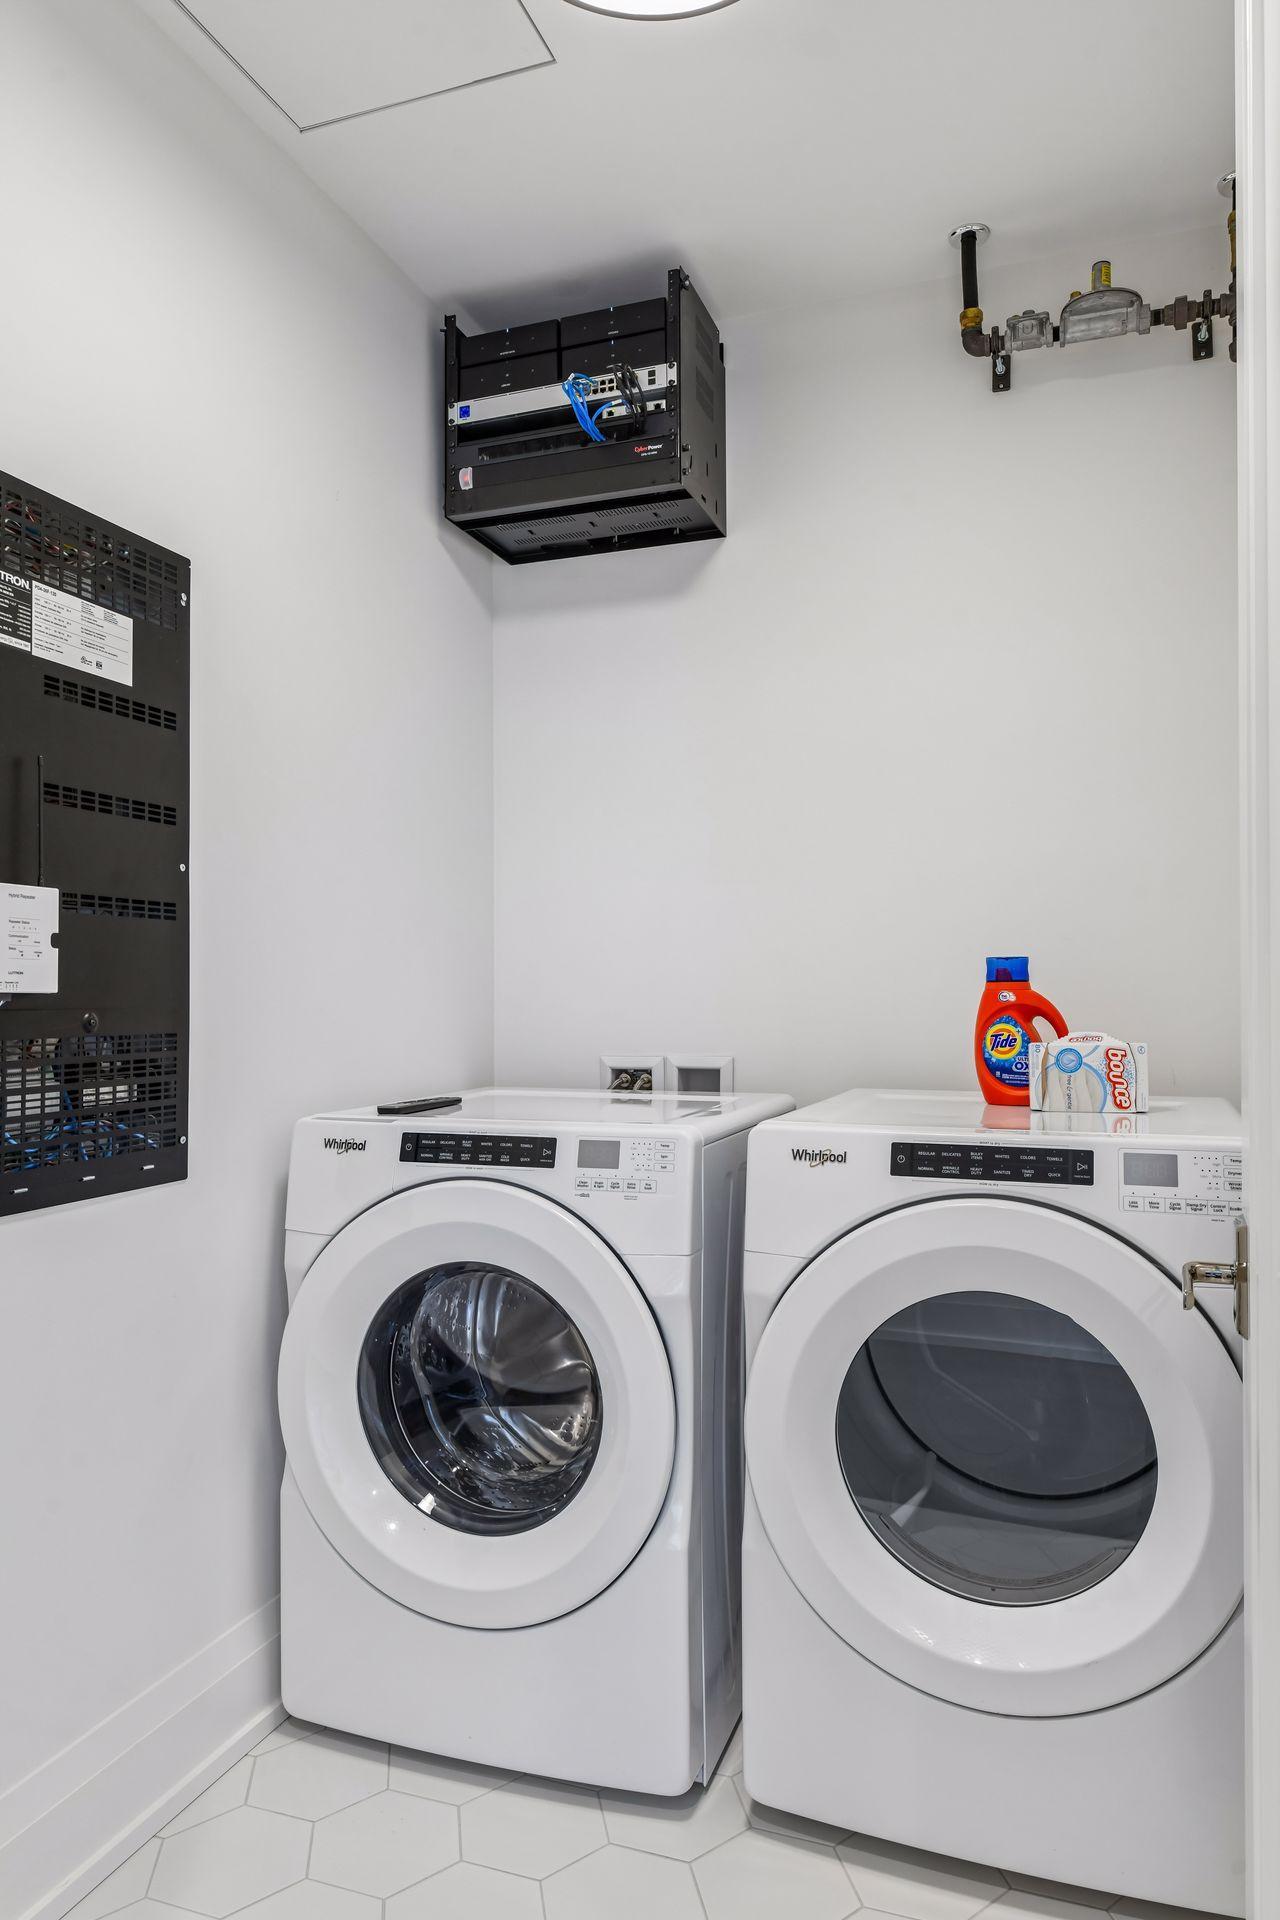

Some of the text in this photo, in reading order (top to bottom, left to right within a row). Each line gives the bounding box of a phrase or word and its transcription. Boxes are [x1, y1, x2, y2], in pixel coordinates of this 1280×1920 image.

[634, 443, 663, 452] CyberPower
[990, 1032, 1018, 1052] Tide
[1105, 1048, 1132, 1110] bounce
[324, 1138, 366, 1153] Whirlpool
[792, 1148, 846, 1167] Whirlpool
